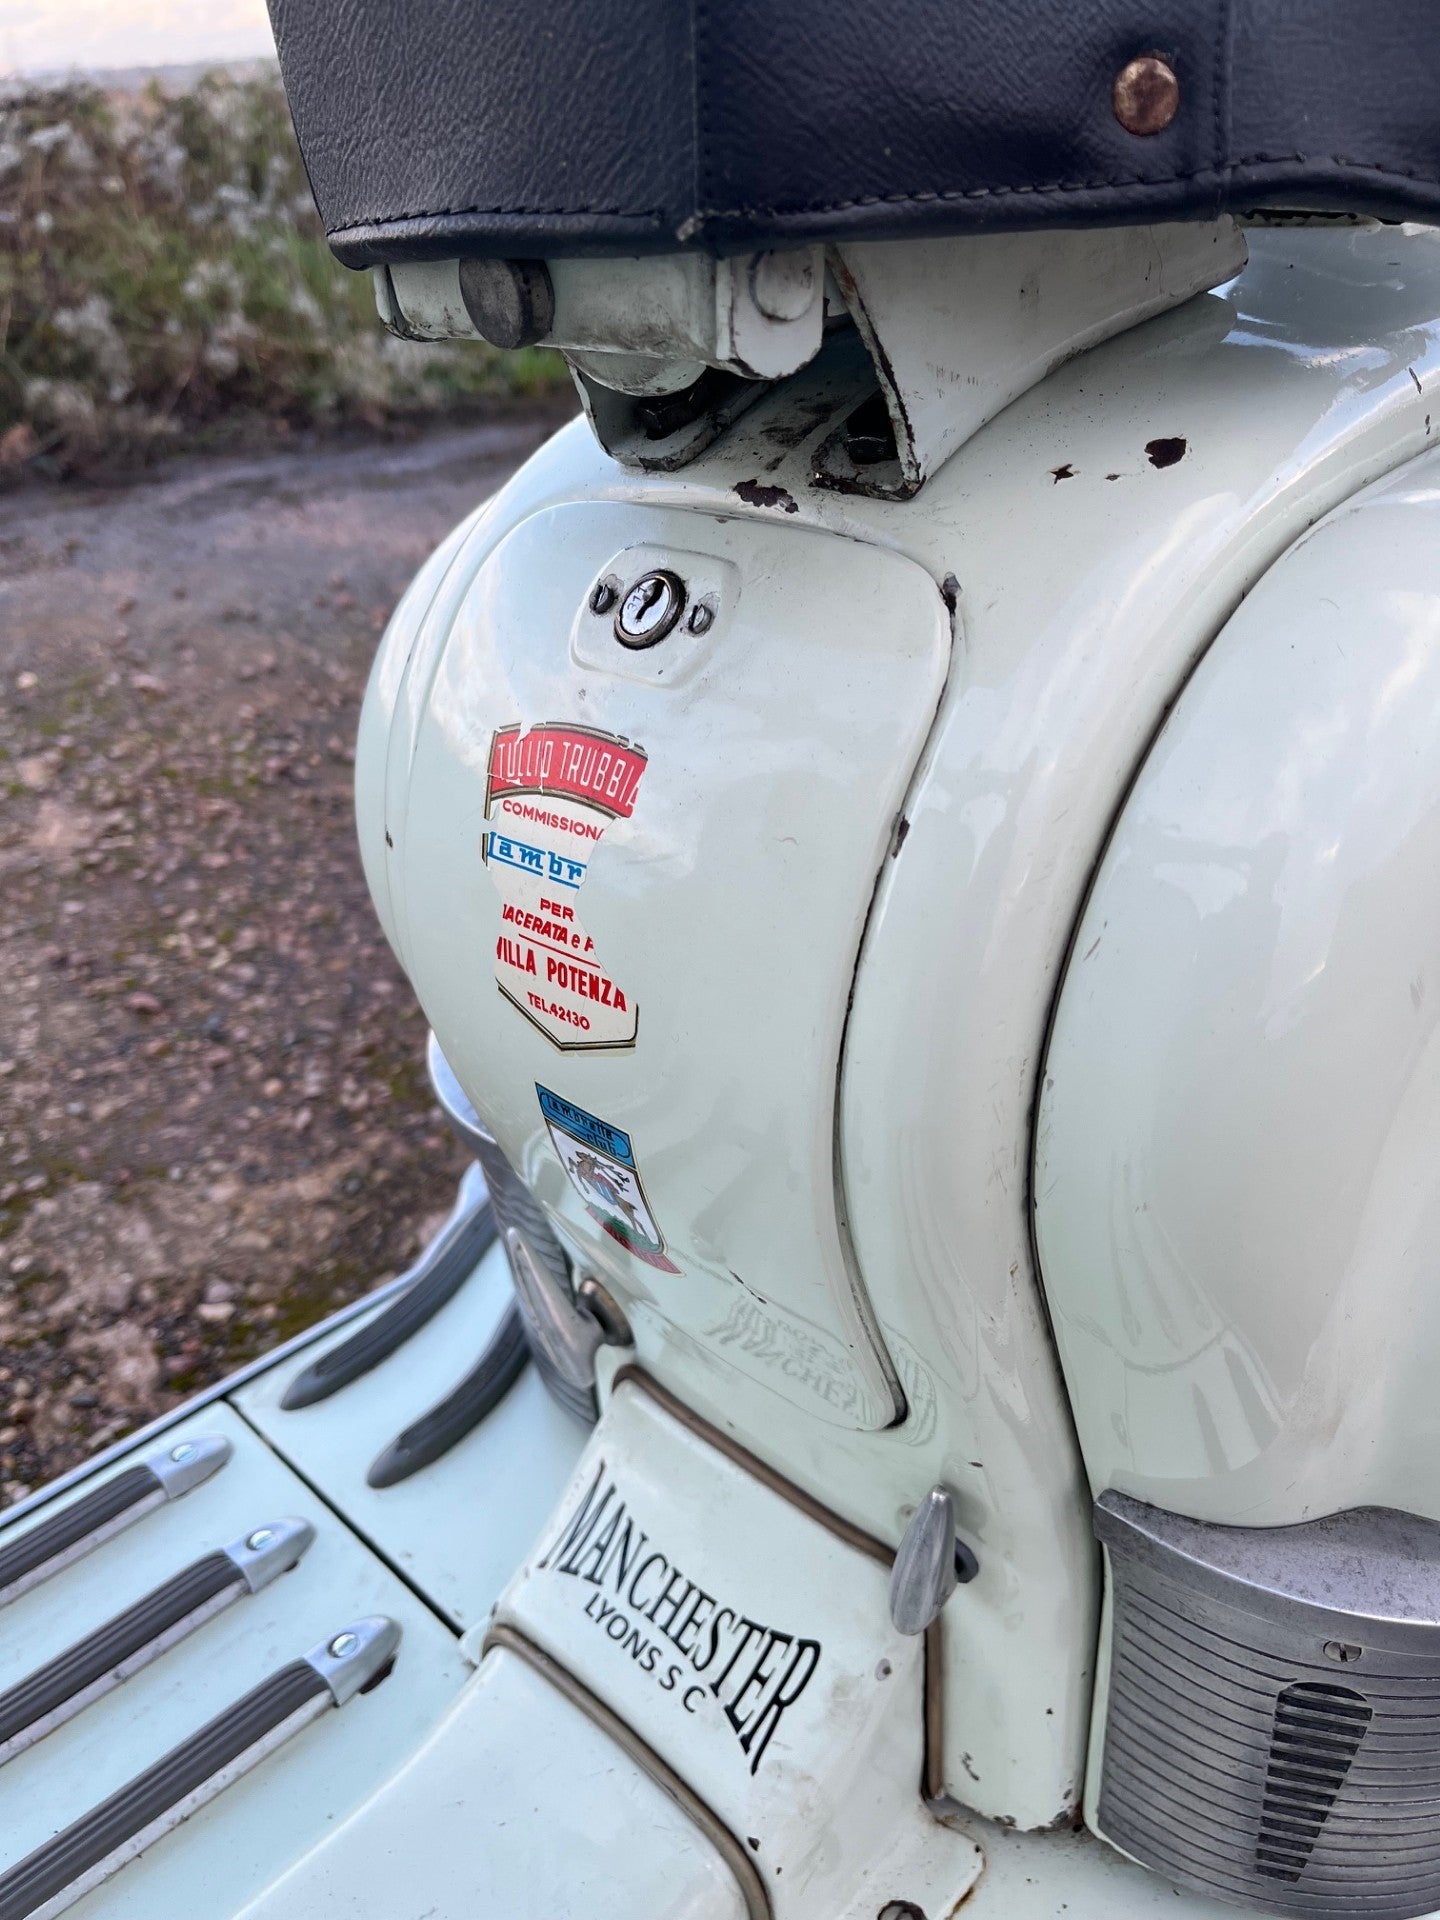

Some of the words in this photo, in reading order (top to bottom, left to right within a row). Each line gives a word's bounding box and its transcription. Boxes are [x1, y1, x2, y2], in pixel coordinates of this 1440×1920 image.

[498, 740, 554, 778] TULLIO
[540, 897, 574, 922] PER
[571, 933, 580, 948] e
[546, 956, 627, 1012] POTENZA
[539, 1457, 821, 1776] MANCHESTER
[583, 1591, 663, 1672] LYONS
[658, 1664, 683, 1691] S
[682, 1685, 707, 1714] C
